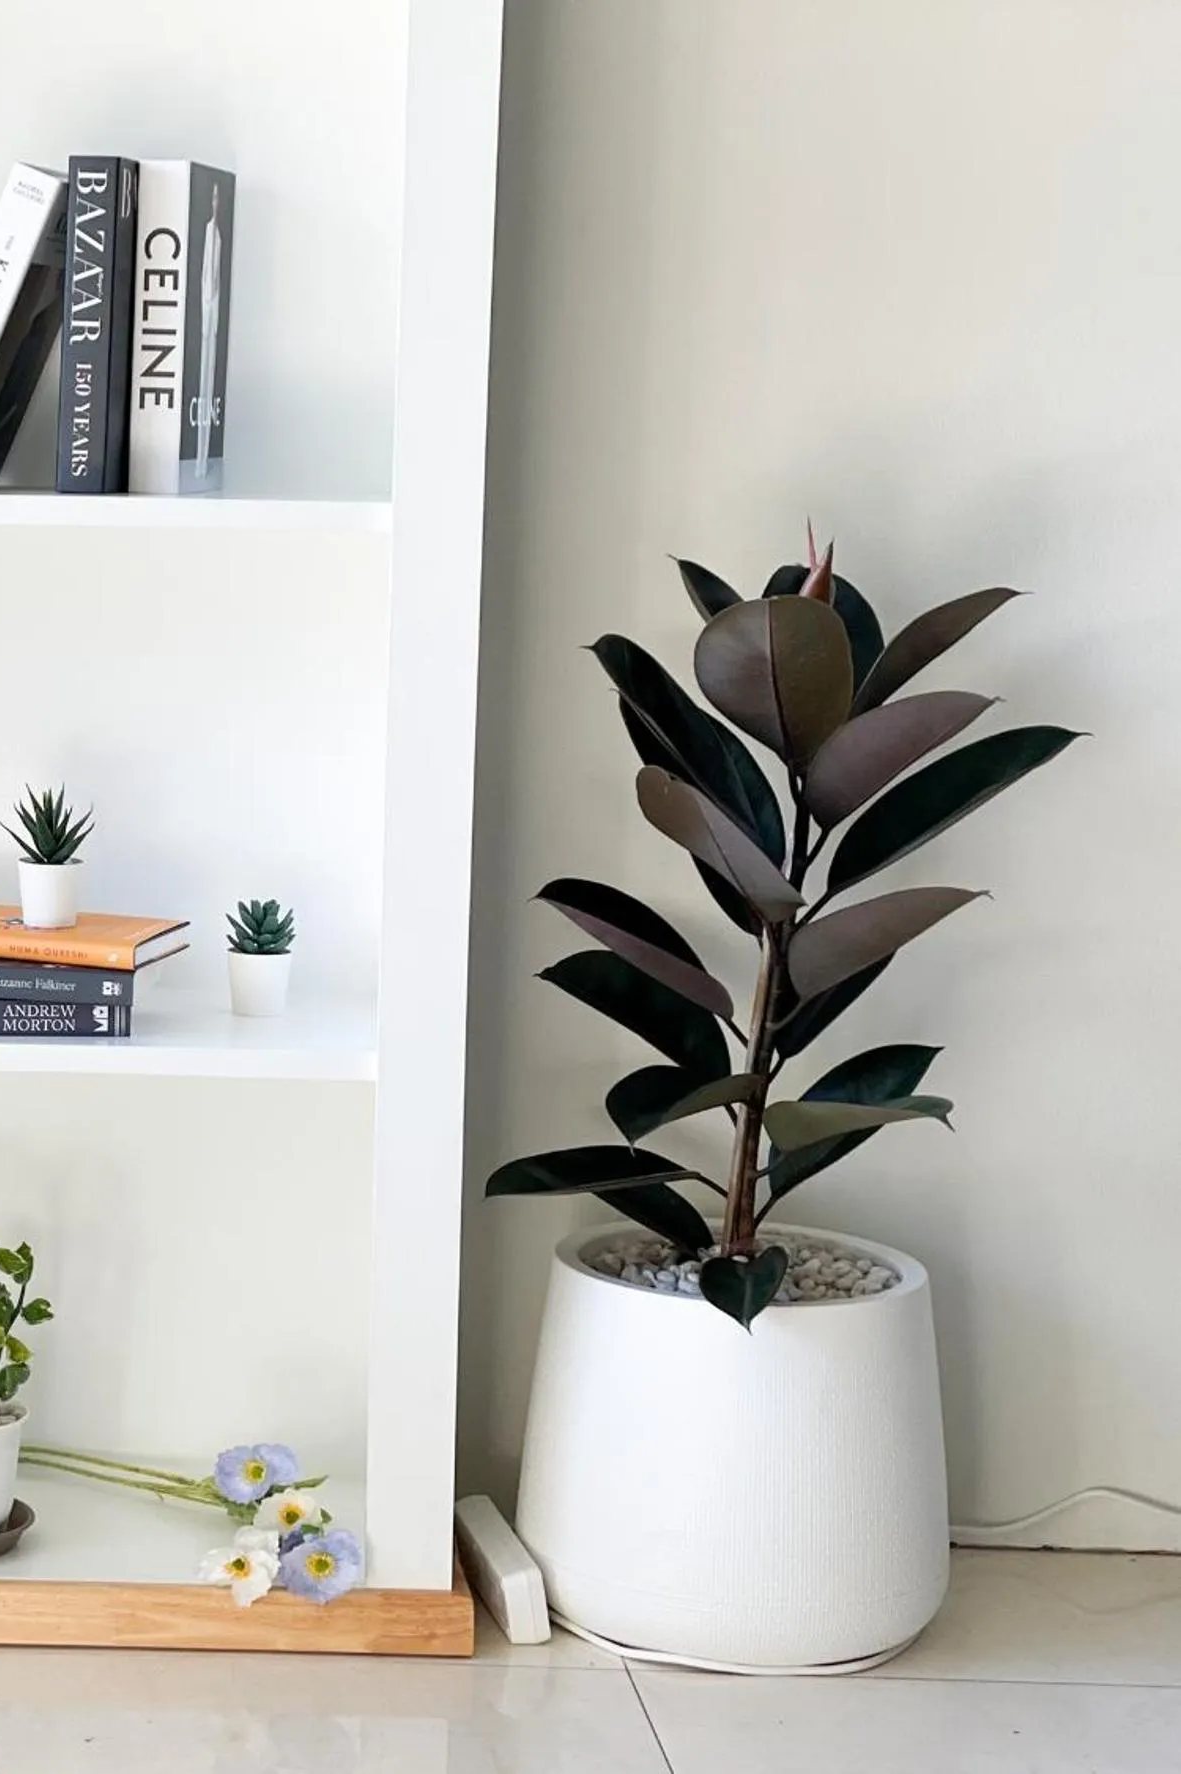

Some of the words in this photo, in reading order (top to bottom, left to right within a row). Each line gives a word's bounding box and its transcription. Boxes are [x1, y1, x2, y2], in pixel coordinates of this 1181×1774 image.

[69, 168, 109, 345] BAZAAR
[138, 227, 181, 410] CELINE
[74, 362, 92, 396] 150
[70, 398, 92, 477] YEARS
[3, 1004, 76, 1017] ANDREW
[3, 1018, 76, 1032] MORTON
